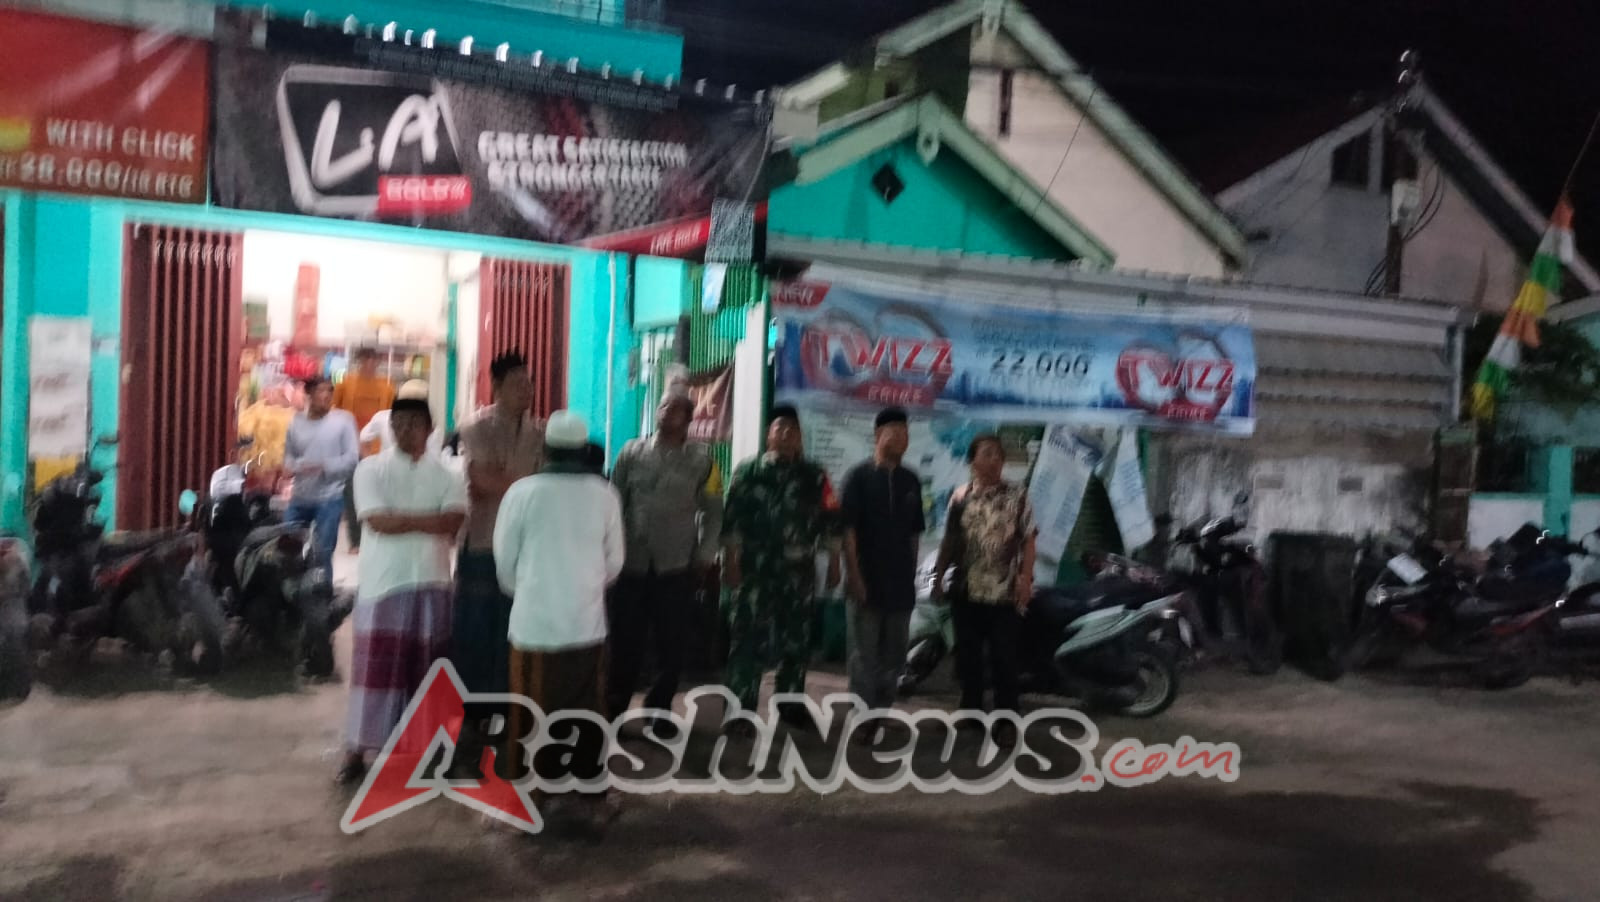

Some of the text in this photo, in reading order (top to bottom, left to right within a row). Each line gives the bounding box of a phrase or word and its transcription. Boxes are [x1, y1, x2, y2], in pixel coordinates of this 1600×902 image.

[46, 117, 196, 162] WITH CLICK
[804, 330, 953, 376] TWIZZ
[990, 347, 1090, 379] 22.000
[1119, 354, 1234, 393] TWIZZ
